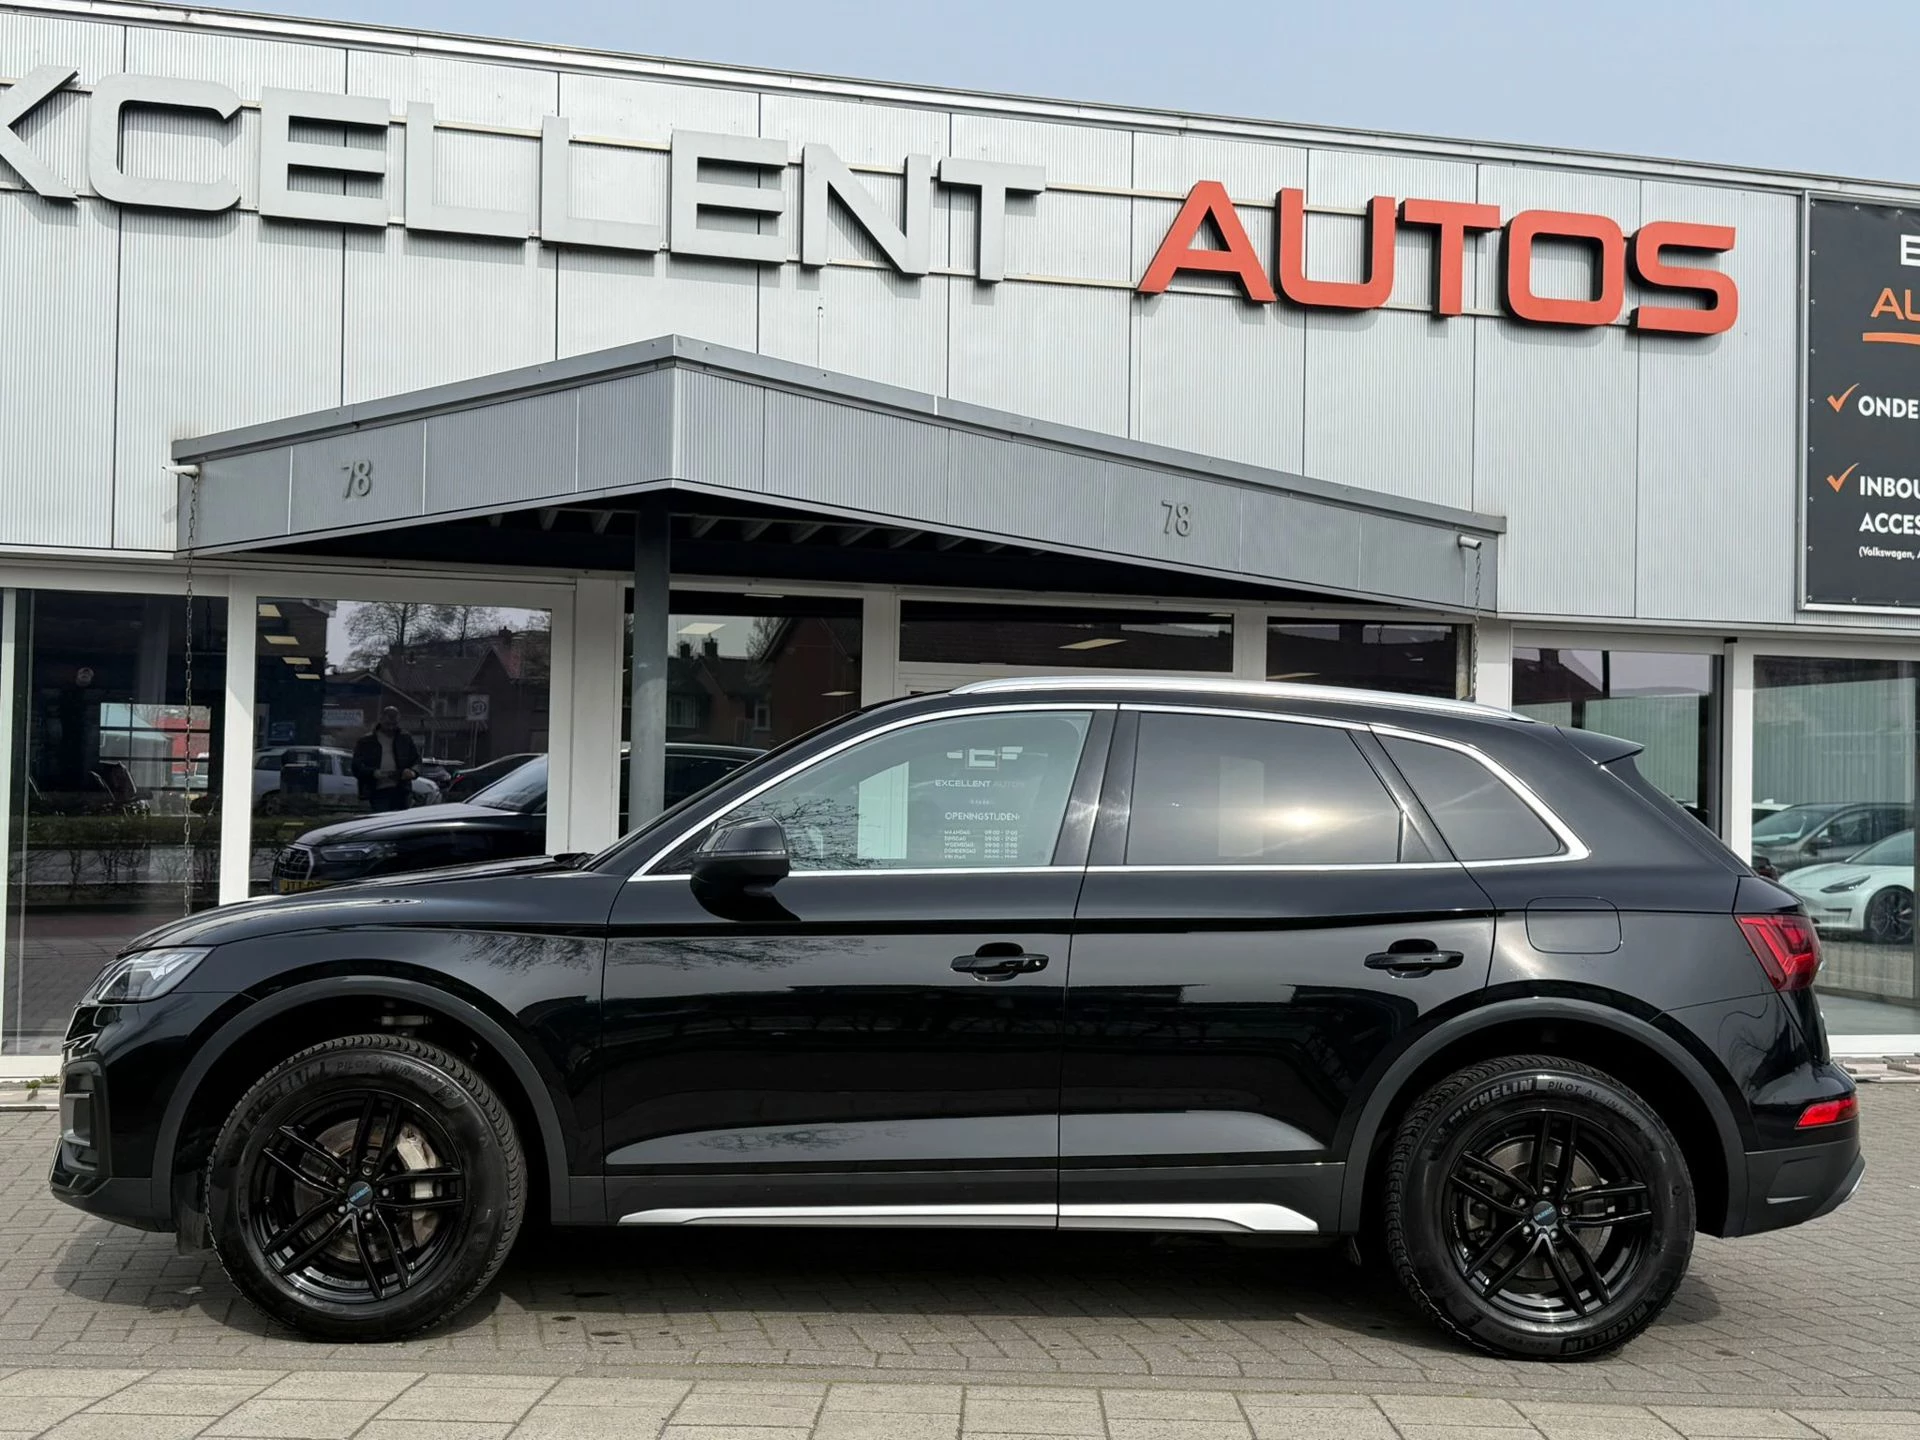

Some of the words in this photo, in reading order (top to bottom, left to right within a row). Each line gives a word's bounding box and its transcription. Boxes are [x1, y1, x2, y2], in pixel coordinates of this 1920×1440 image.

[1137, 180, 1739, 335] AUTOS
[1858, 395, 1919, 420] ONDE
[340, 459, 372, 499] 78
[1161, 499, 1191, 538] 78
[1859, 546, 1915, 560] (Volkswagen,
[934, 779, 992, 788] EXCELLENT
[1448, 1079, 1534, 1124] MICHELIN
[1548, 1080, 1582, 1094] PILOT
